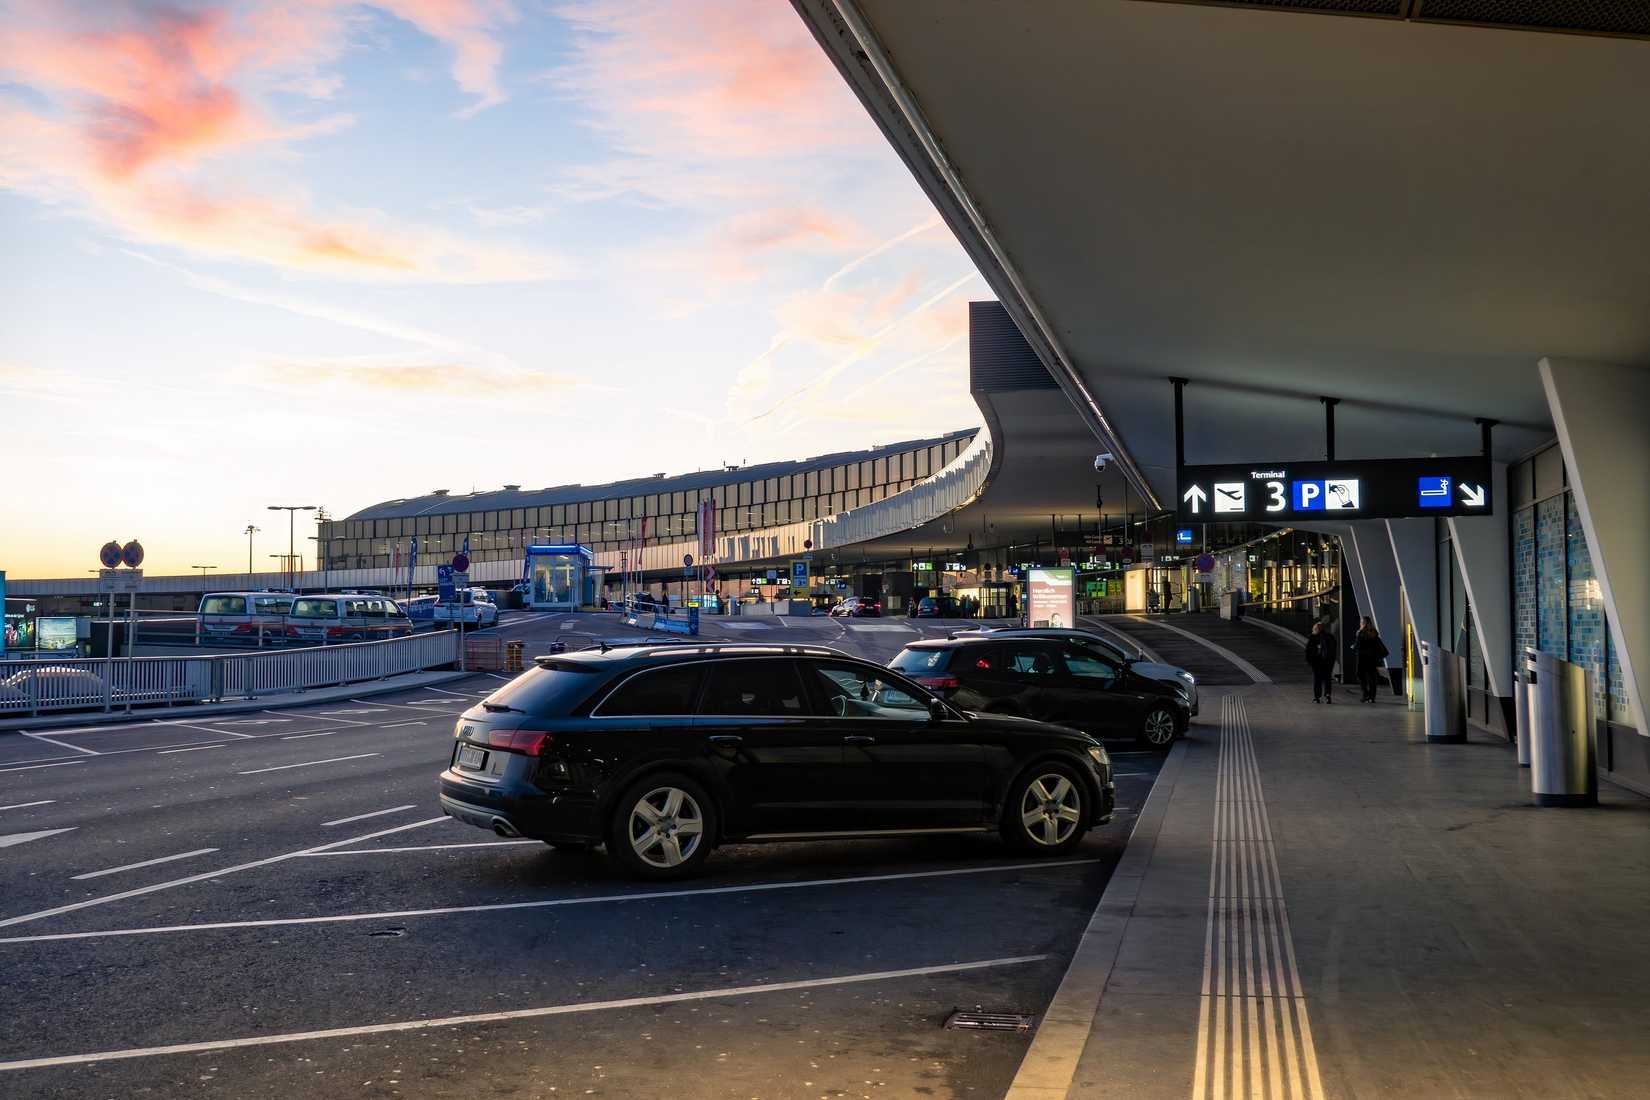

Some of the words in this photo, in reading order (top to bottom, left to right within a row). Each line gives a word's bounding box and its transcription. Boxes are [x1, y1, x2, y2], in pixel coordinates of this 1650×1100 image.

[1251, 470, 1286, 479] Terminal
[1265, 481, 1286, 512] 3
[1301, 483, 1320, 508] P
[796, 563, 804, 575] P
